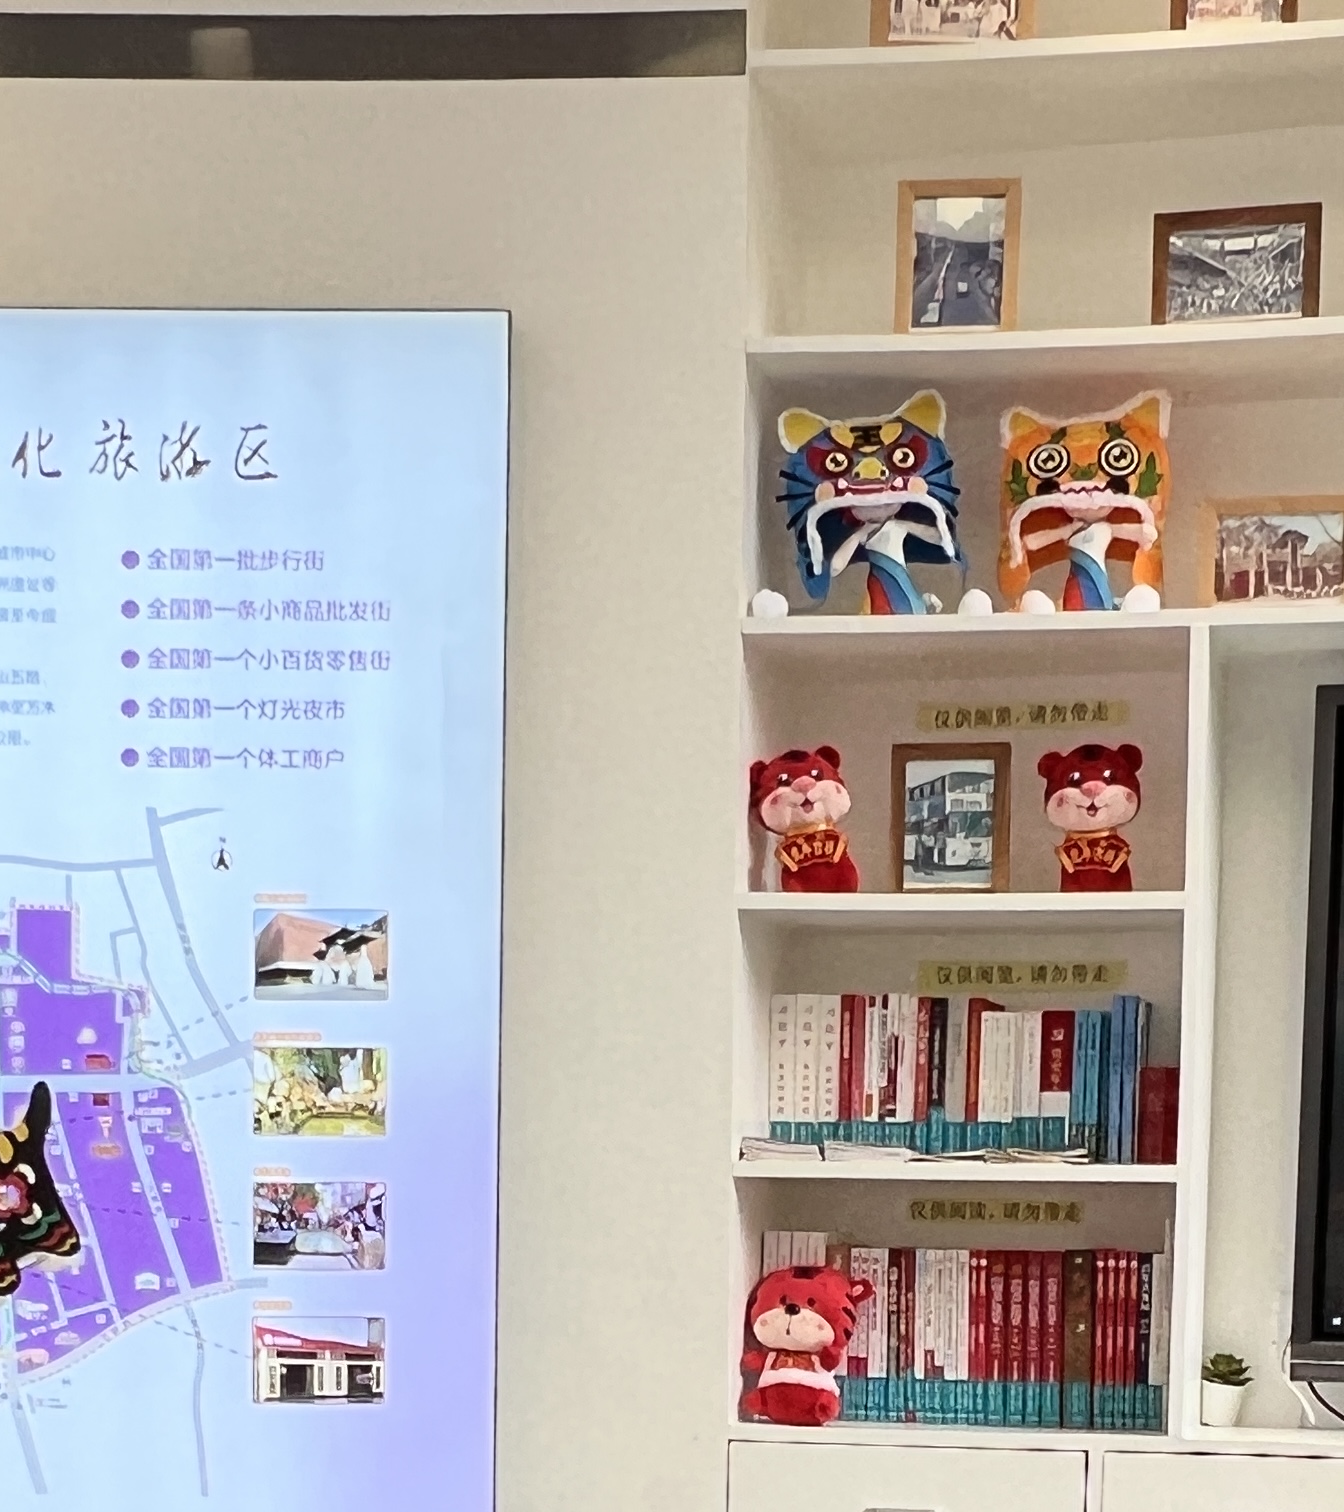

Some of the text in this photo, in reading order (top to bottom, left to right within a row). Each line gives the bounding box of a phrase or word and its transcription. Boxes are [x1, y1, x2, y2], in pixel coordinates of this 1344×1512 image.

[147, 547, 325, 571] 全国第一批步行街
[147, 697, 346, 720] 全国第一个灯光夜市
